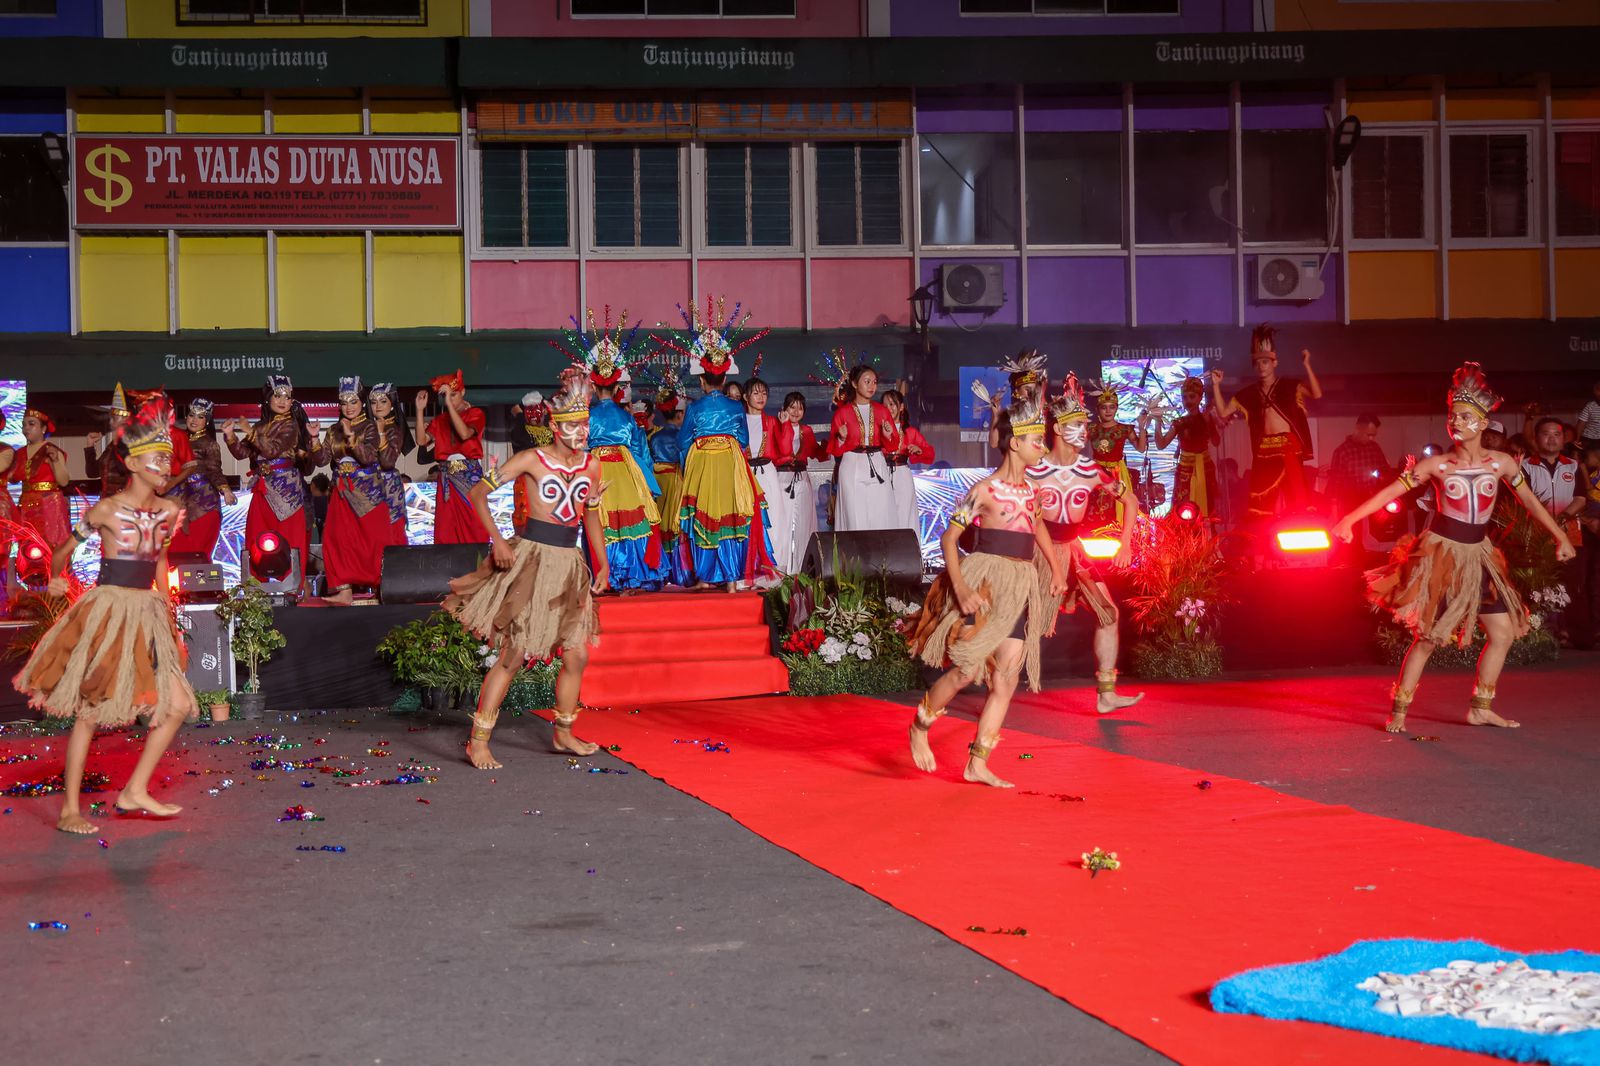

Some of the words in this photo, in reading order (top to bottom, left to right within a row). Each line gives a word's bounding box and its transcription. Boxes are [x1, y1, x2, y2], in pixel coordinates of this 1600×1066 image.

[171, 45, 328, 70] Tanjungpinang
[643, 44, 795, 69] Tanjungpinang
[1155, 41, 1305, 64] Tanjungpinang
[145, 146, 186, 184] PT.
[194, 146, 280, 185] VALAS
[288, 147, 363, 185] DUTA
[369, 147, 443, 186] NUSA
[165, 190, 184, 200] JL.
[188, 190, 249, 200] MERDEKA
[294, 191, 326, 201] TELP.
[329, 191, 367, 202] (0771)
[1569, 336, 1600, 352] Tan
[165, 354, 285, 372] Tanjungpinang
